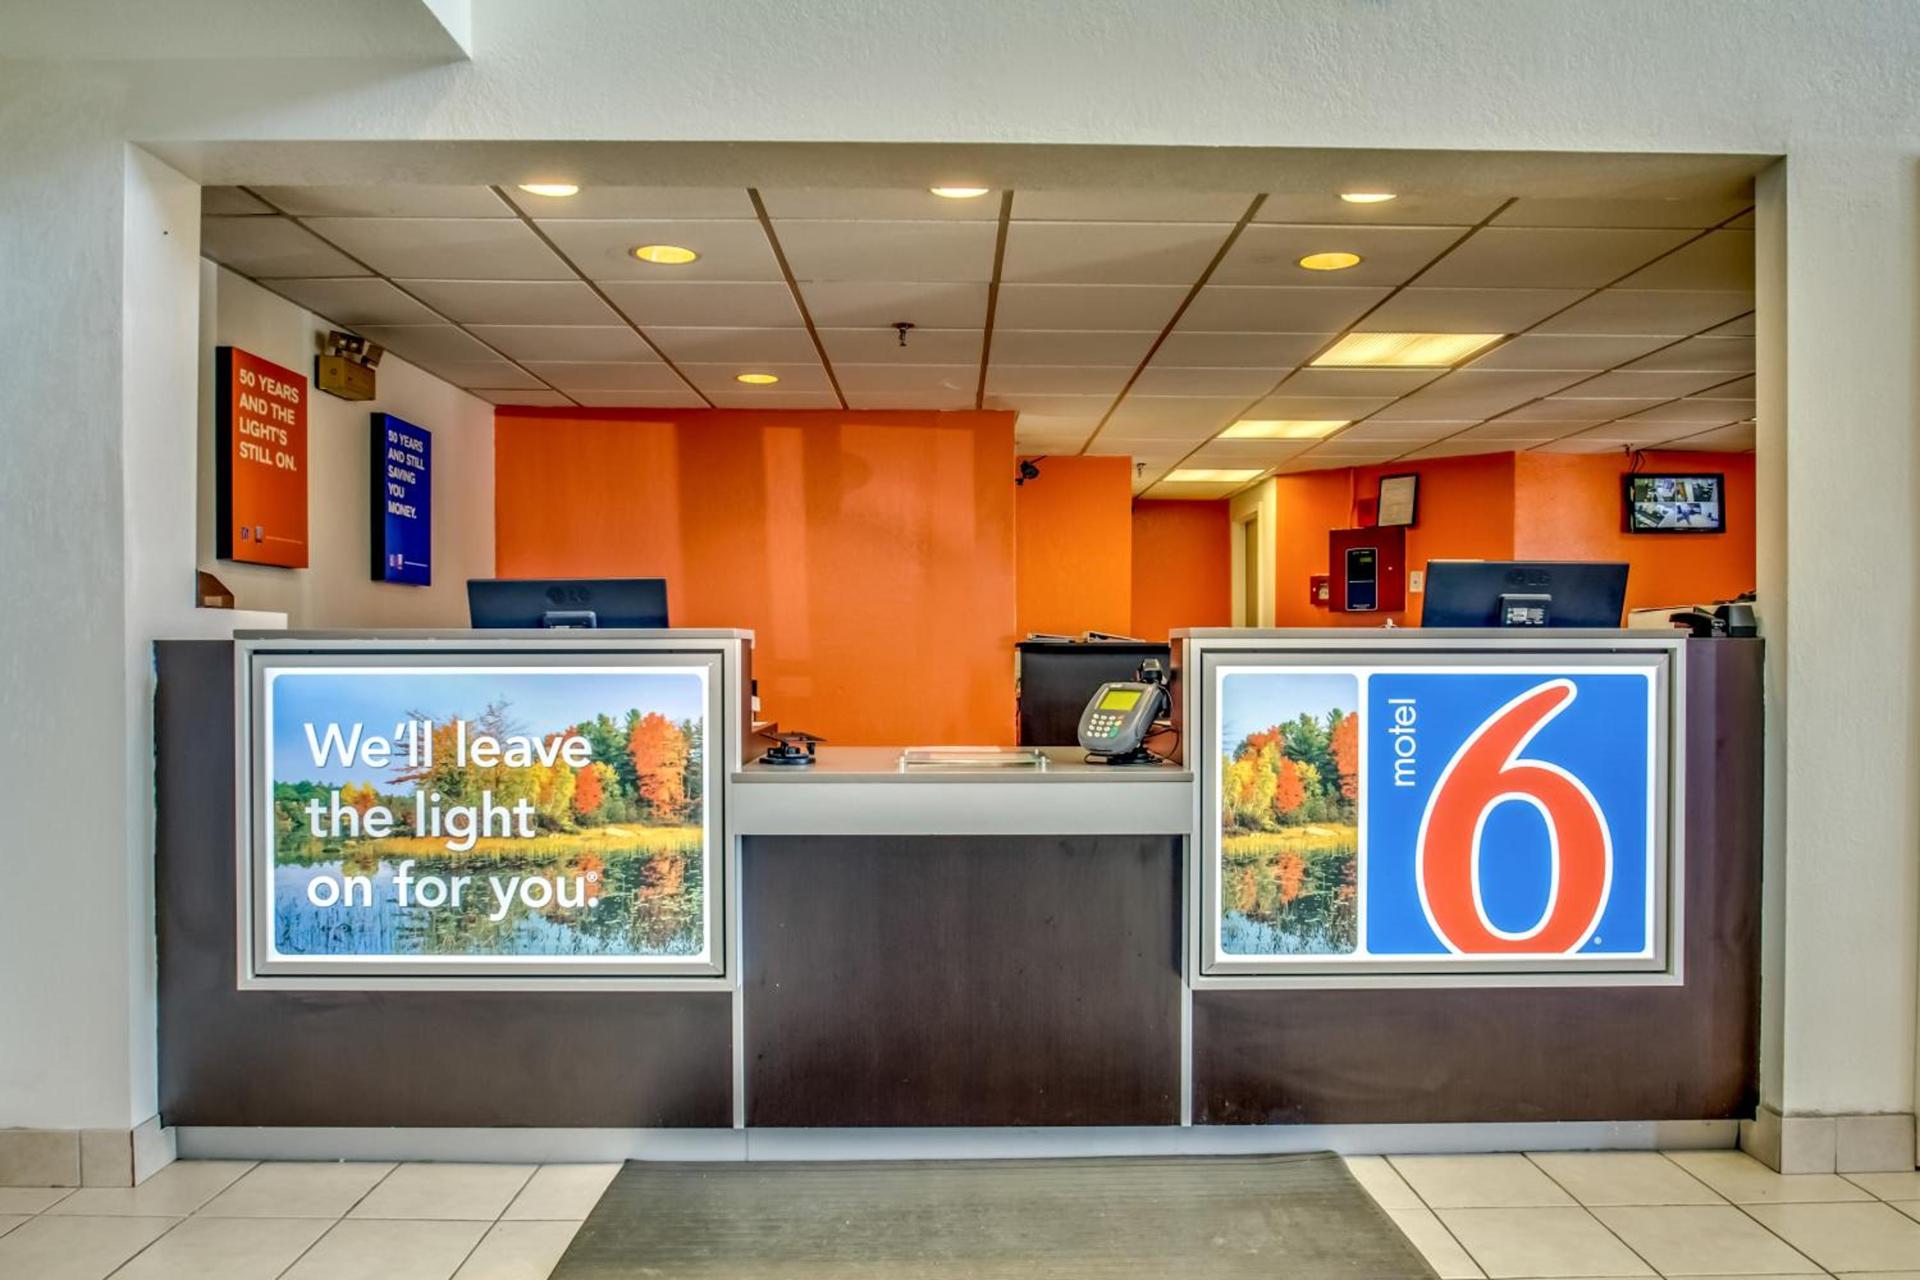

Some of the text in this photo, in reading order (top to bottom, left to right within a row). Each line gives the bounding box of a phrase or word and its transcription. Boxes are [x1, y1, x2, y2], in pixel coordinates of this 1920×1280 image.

[239, 368, 300, 404] 50 YEARS
[239, 392, 296, 426] AND THE
[239, 416, 288, 446] LIGHT'S
[399, 433, 423, 454] YEARS
[239, 441, 298, 471] STILL ON.
[387, 447, 426, 471] AND STILL
[387, 464, 416, 485] SAVING
[387, 482, 405, 499] YOU
[387, 500, 417, 519] MONEY.
[304, 720, 593, 769] We'll leave
[305, 790, 536, 852] the light
[1388, 678, 1614, 954] motel 6
[306, 873, 373, 909] on
[393, 859, 472, 909] for
